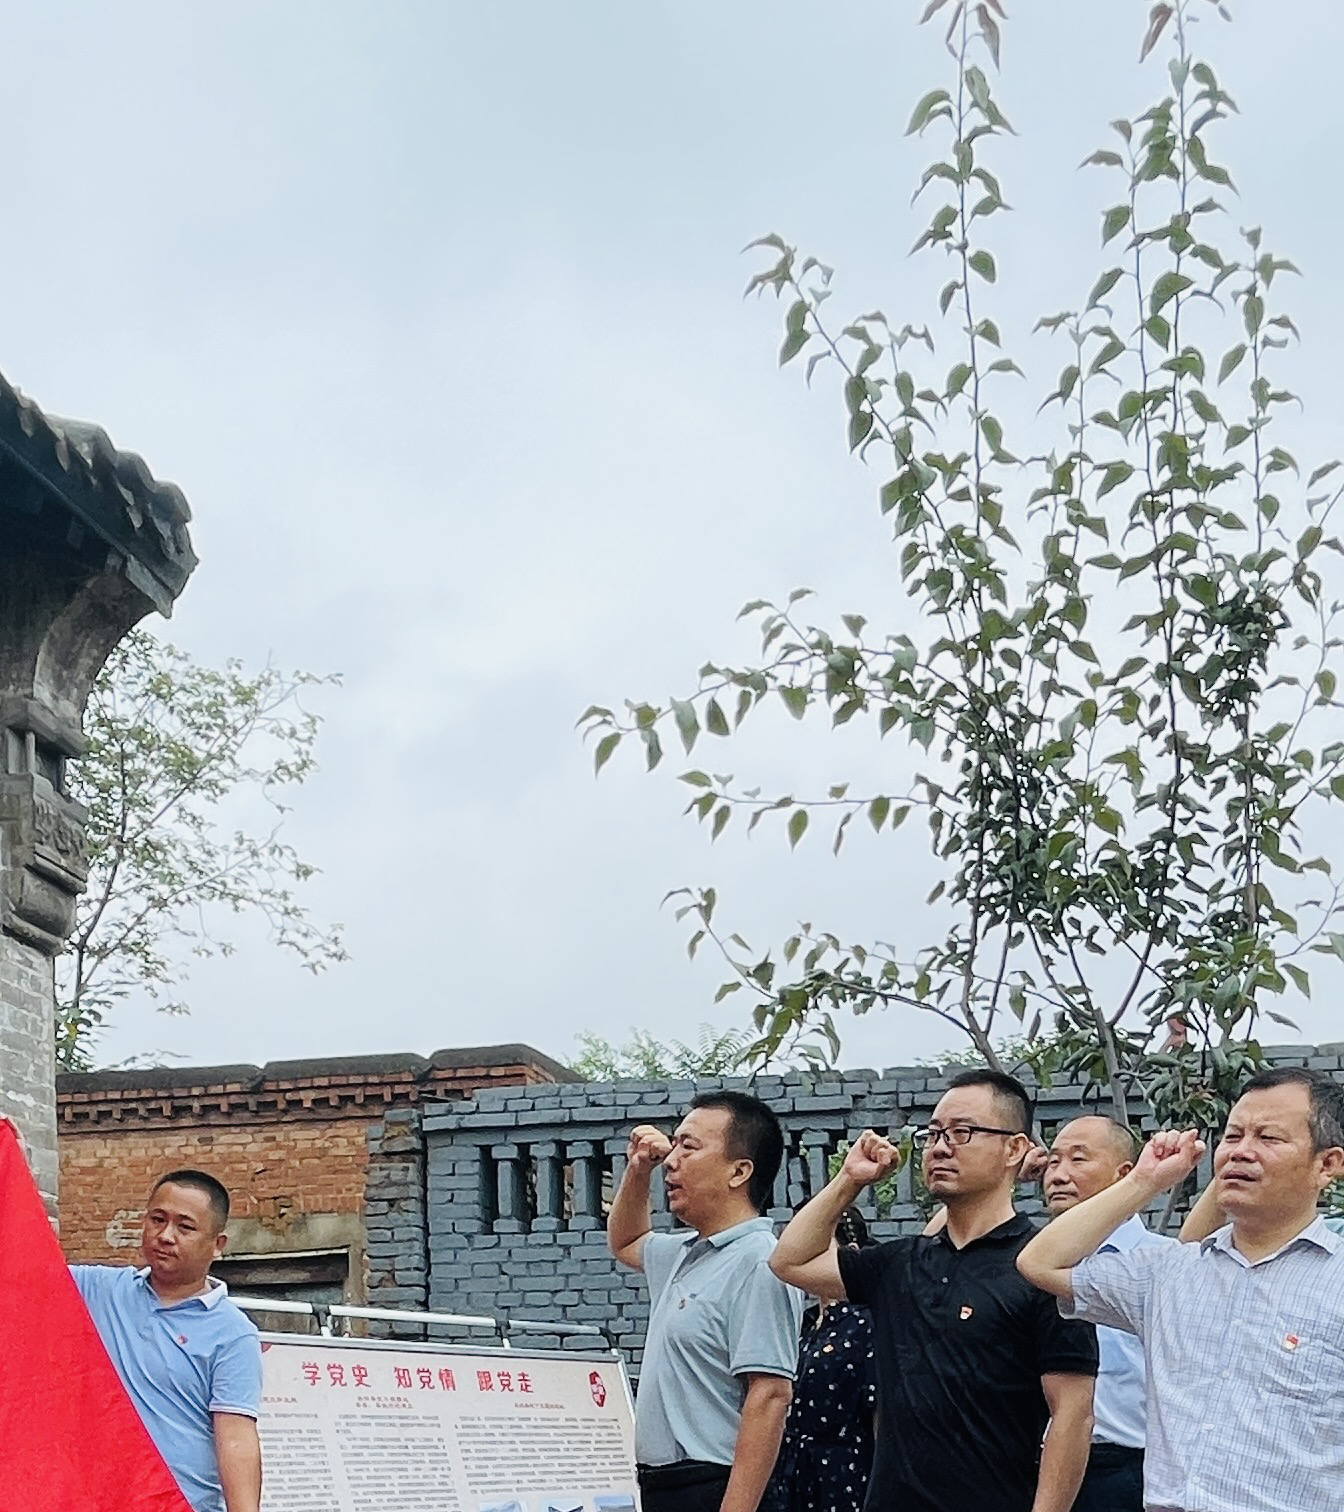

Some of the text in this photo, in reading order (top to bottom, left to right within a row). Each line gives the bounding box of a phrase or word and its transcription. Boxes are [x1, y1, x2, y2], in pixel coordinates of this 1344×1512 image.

[302, 1361, 534, 1394] 学党史 知党情 跟党走
